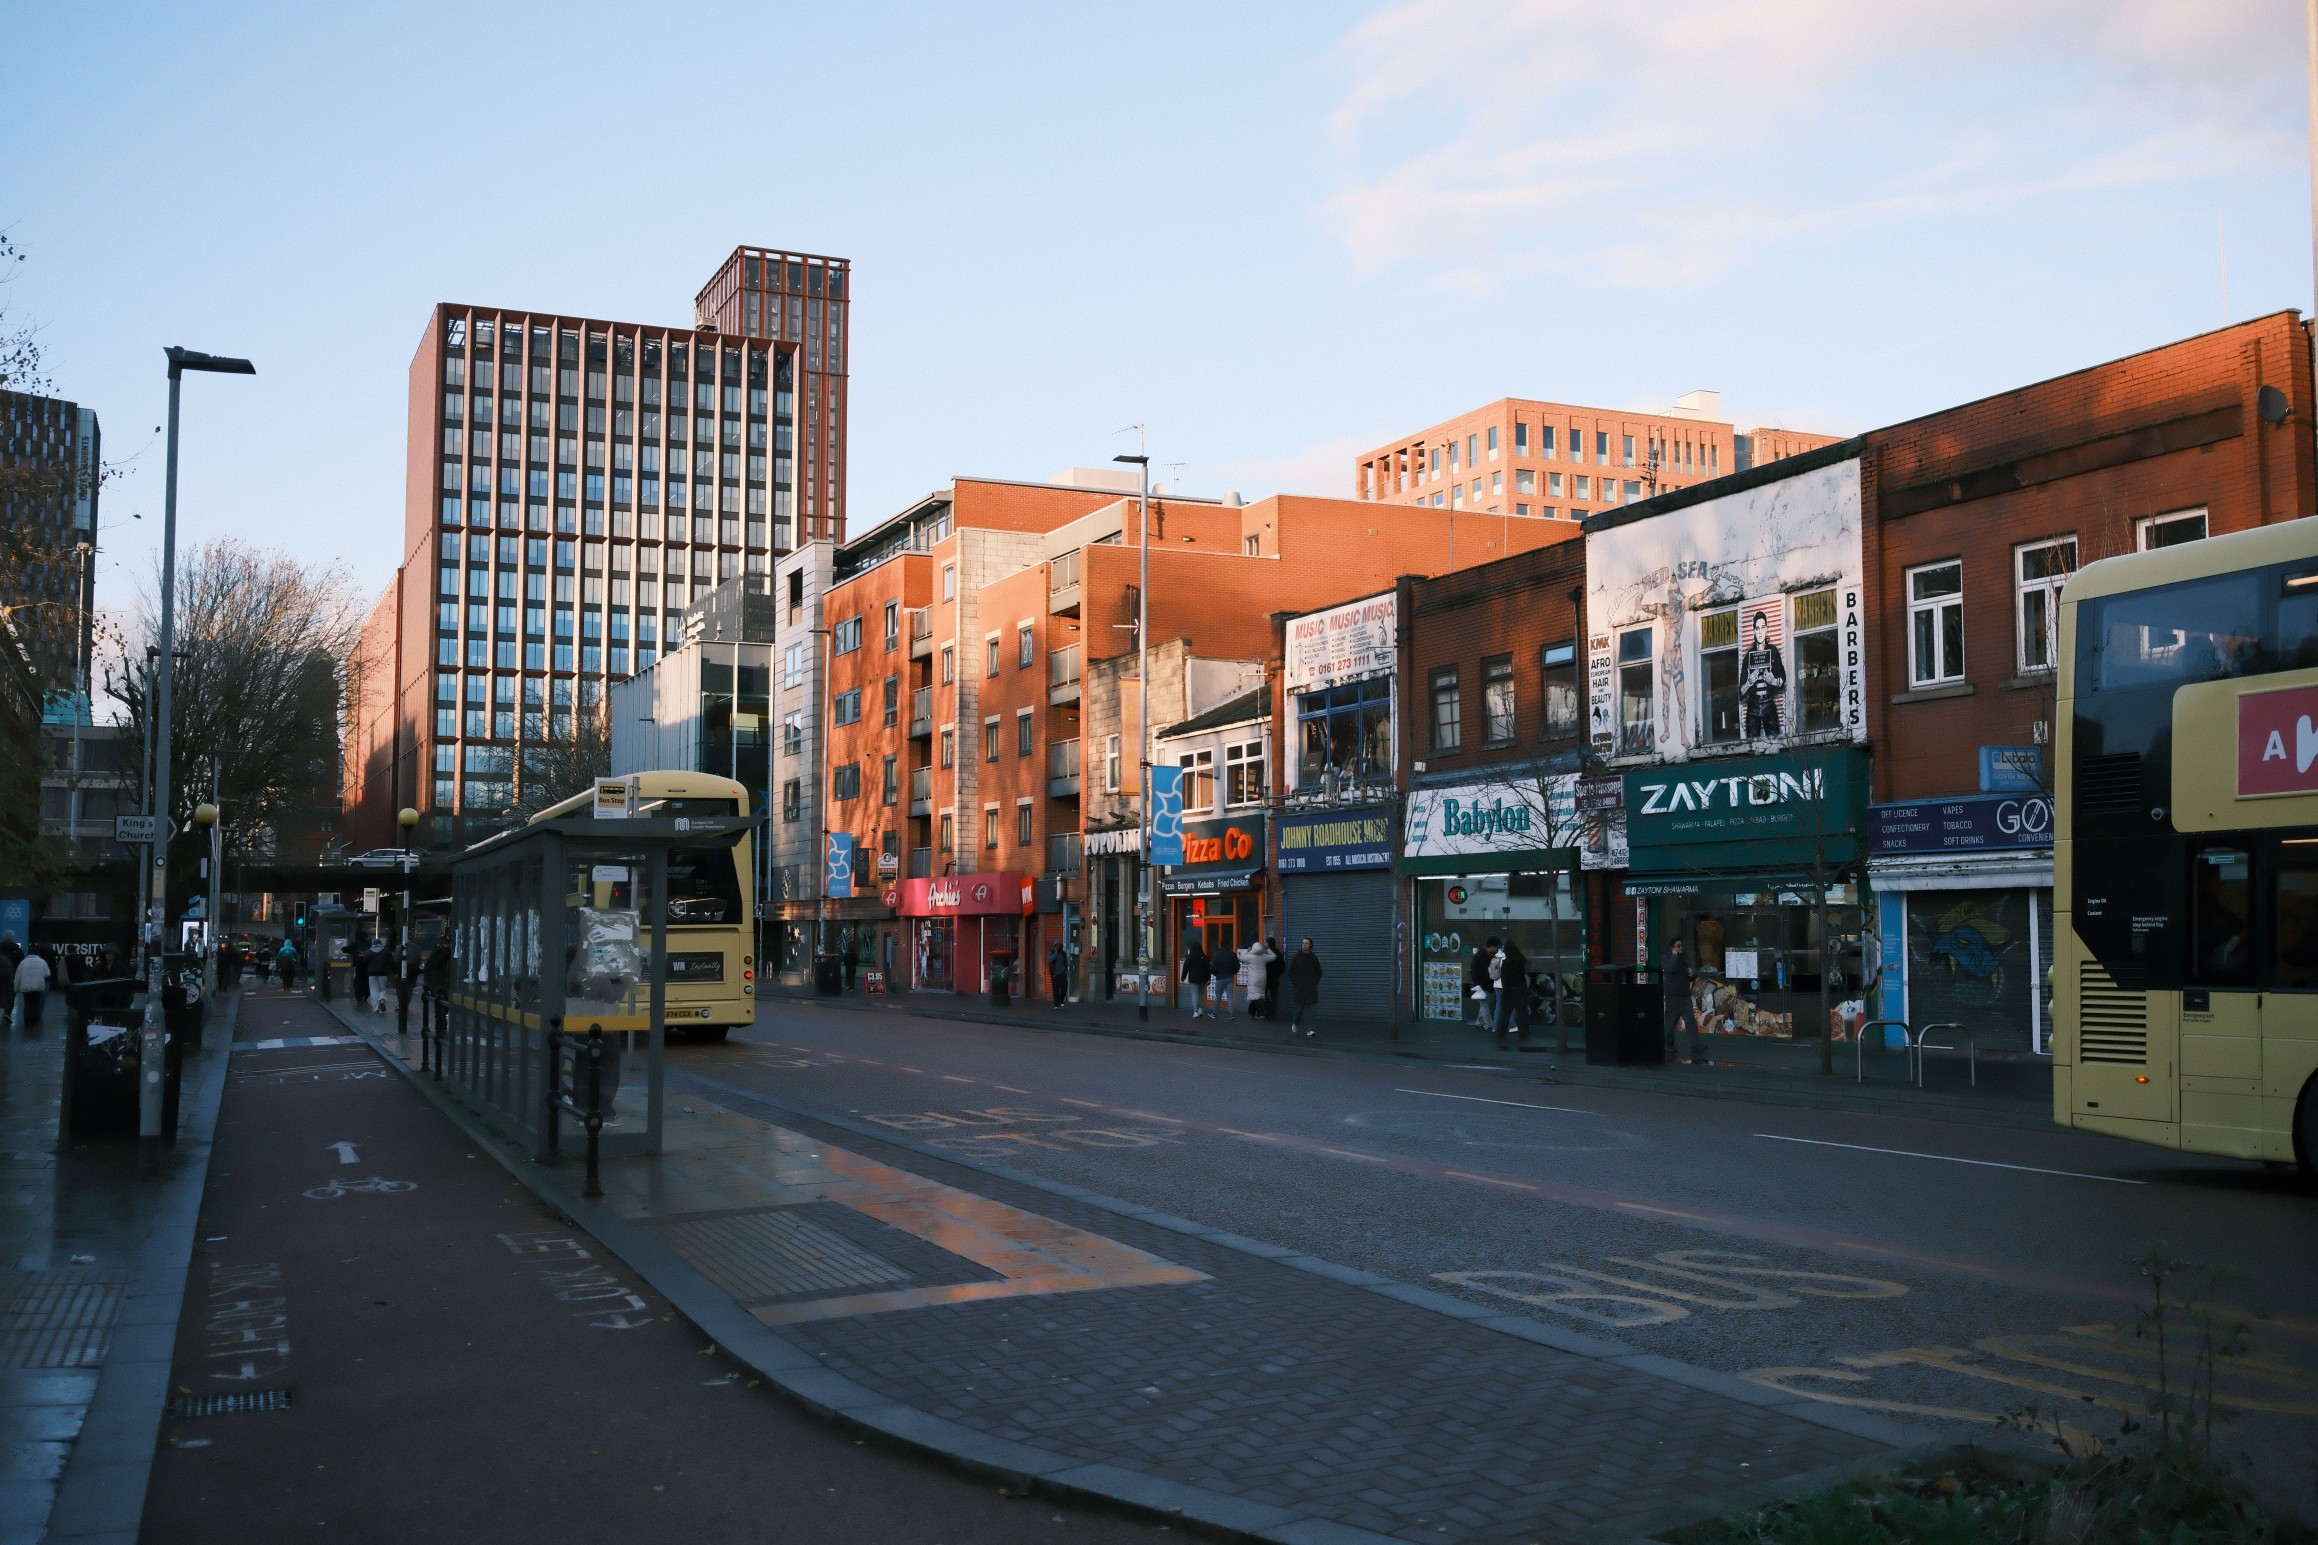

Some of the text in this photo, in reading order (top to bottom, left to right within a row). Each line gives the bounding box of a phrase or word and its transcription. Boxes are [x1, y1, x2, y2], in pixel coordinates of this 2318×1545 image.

[1642, 561, 1708, 593] RED SEA
[1295, 600, 1394, 640] MUSIC MUSIC MUSIC
[1590, 636, 1610, 651] KMK
[1318, 663, 1335, 674] 0161
[1337, 658, 1351, 671] 273
[1353, 654, 1370, 667] 1111
[1590, 657, 1610, 670] AFRO
[1846, 592, 1860, 725] BARBERS
[1590, 670, 1611, 678] EUROPEAN
[1592, 677, 1609, 689] HAIR
[1591, 693, 1612, 706] BEAUTY
[2262, 730, 2287, 761] A
[1640, 768, 1824, 815] ZAYTONI
[1893, 808, 1918, 818] LICENCE
[1942, 806, 1963, 815] VAPES
[122, 819, 154, 828] King's
[1443, 797, 1530, 841] Babylon
[1671, 820, 1701, 830] SHAWARMA
[1704, 819, 1725, 828] FALAFEL
[1729, 817, 1745, 826] PIZZA
[1771, 814, 1793, 823] BURGER
[1943, 820, 1972, 830] TOBACCO
[1281, 825, 1312, 849] JOHNNY
[1314, 820, 1363, 847] ROADHOUSE
[1881, 823, 1930, 834] CONFECTIONERY
[1224, 826, 1254, 861] Co
[1882, 839, 1907, 849] SNACKS
[1943, 836, 1984, 845] SOFT DRINKS
[2018, 832, 2054, 843] CONVENIEN
[1161, 878, 1249, 891] Pizzas Burgers Kebabs Fried Chicken
[1636, 885, 1699, 895] ZAYTONI SHAWARMA
[928, 880, 960, 910] Archie's
[860, 1107, 1083, 1130] BUS
[924, 1128, 1187, 1158] STOP
[1429, 1249, 1910, 1327] BUS
